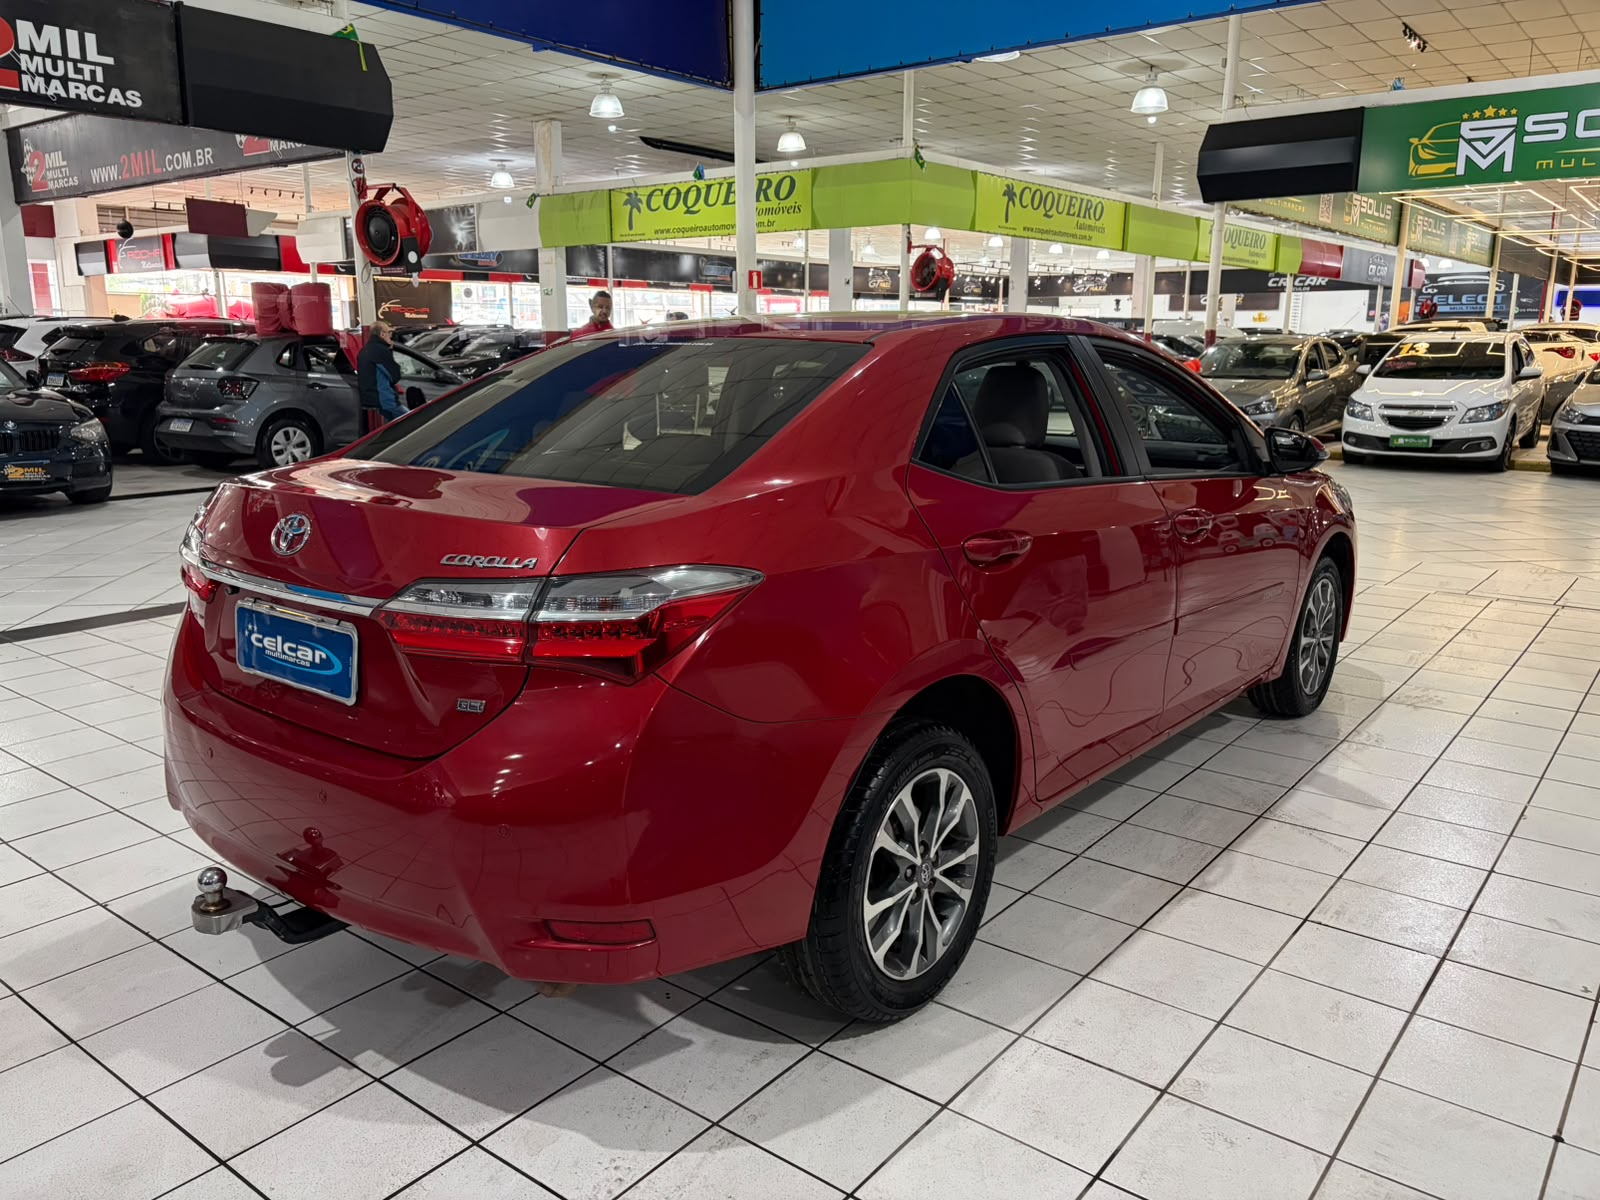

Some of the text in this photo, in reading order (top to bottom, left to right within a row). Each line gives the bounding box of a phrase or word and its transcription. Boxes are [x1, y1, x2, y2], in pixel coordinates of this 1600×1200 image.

[16, 19, 115, 65] MIL
[20, 53, 104, 83] MULTI
[21, 74, 143, 108] MARCAS
[1523, 108, 1600, 143] SO
[270, 139, 306, 152] MAR
[29, 150, 67, 192] 2 MIL
[46, 167, 69, 180] MULTI
[1535, 157, 1597, 170] MUL
[48, 176, 79, 190] MARCAS
[645, 174, 797, 215] COQUERO
[756, 201, 803, 216] omóveis
[1019, 185, 1105, 222] COQUEIRO
[1360, 196, 1393, 220] SOLUS
[1223, 226, 1267, 249] OQUEIRO
[1294, 275, 1329, 287] CAR
[440, 553, 539, 569] COROLLA
[251, 632, 328, 665] celcar
[265, 649, 311, 668] multimarcas
